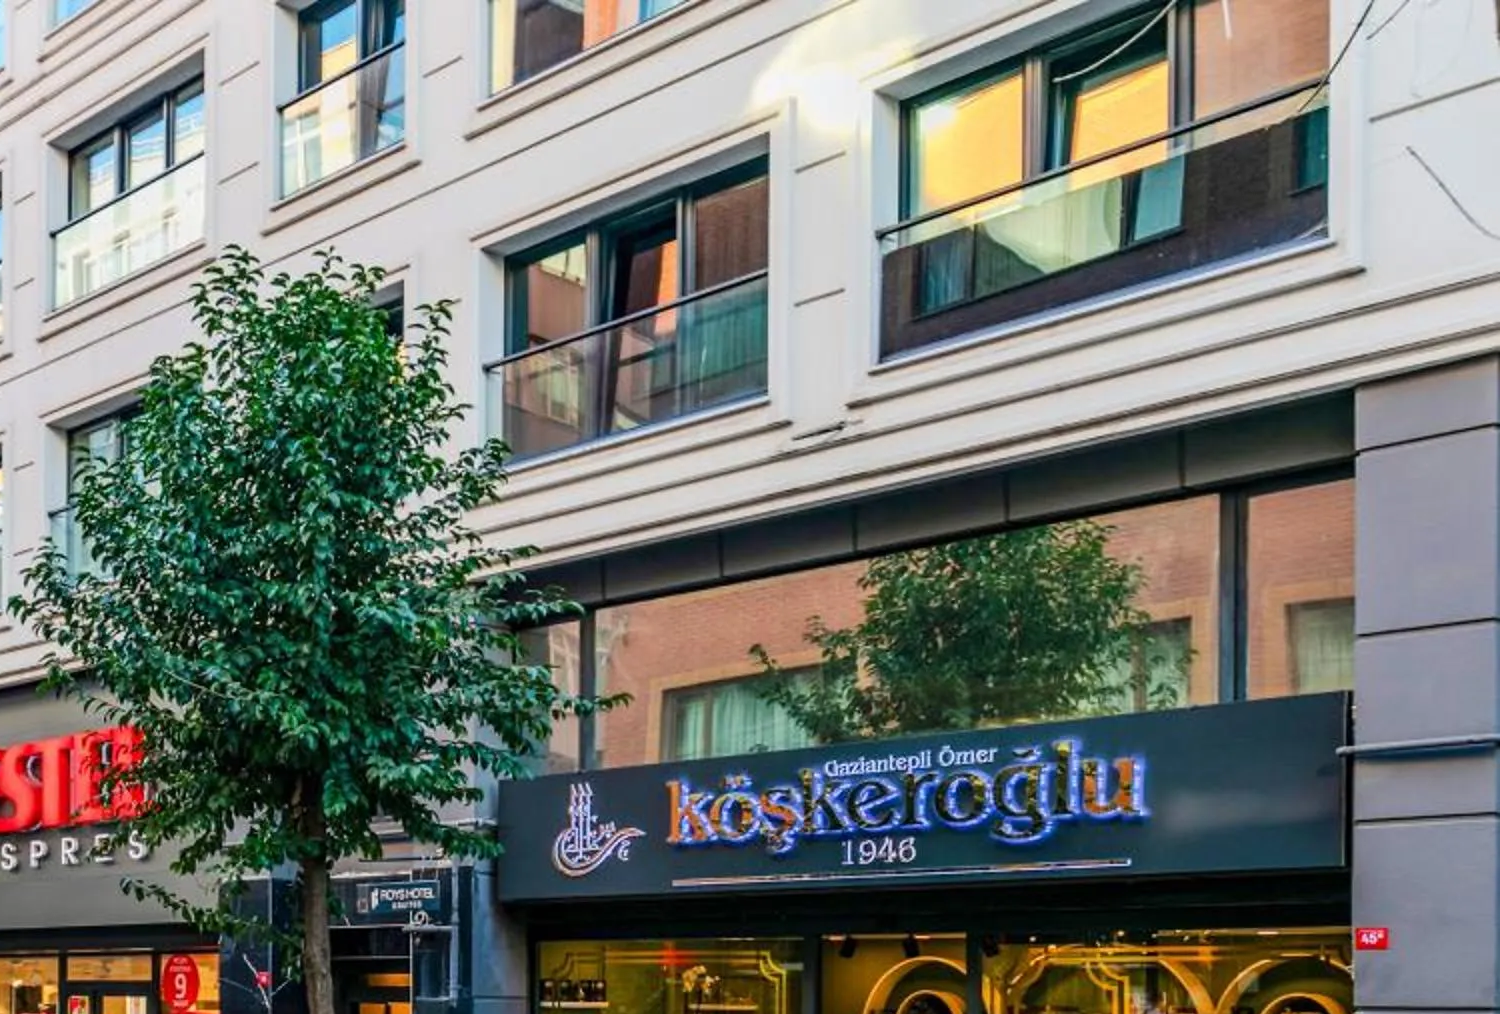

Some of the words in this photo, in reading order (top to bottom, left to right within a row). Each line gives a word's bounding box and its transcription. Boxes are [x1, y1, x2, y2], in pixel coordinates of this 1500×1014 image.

[824, 750, 932, 780] Gaziantepli
[938, 745, 998, 767] Ömer
[665, 737, 1150, 858] köşkeroğlu
[841, 836, 917, 865] 1946
[174, 973, 188, 999] 9
